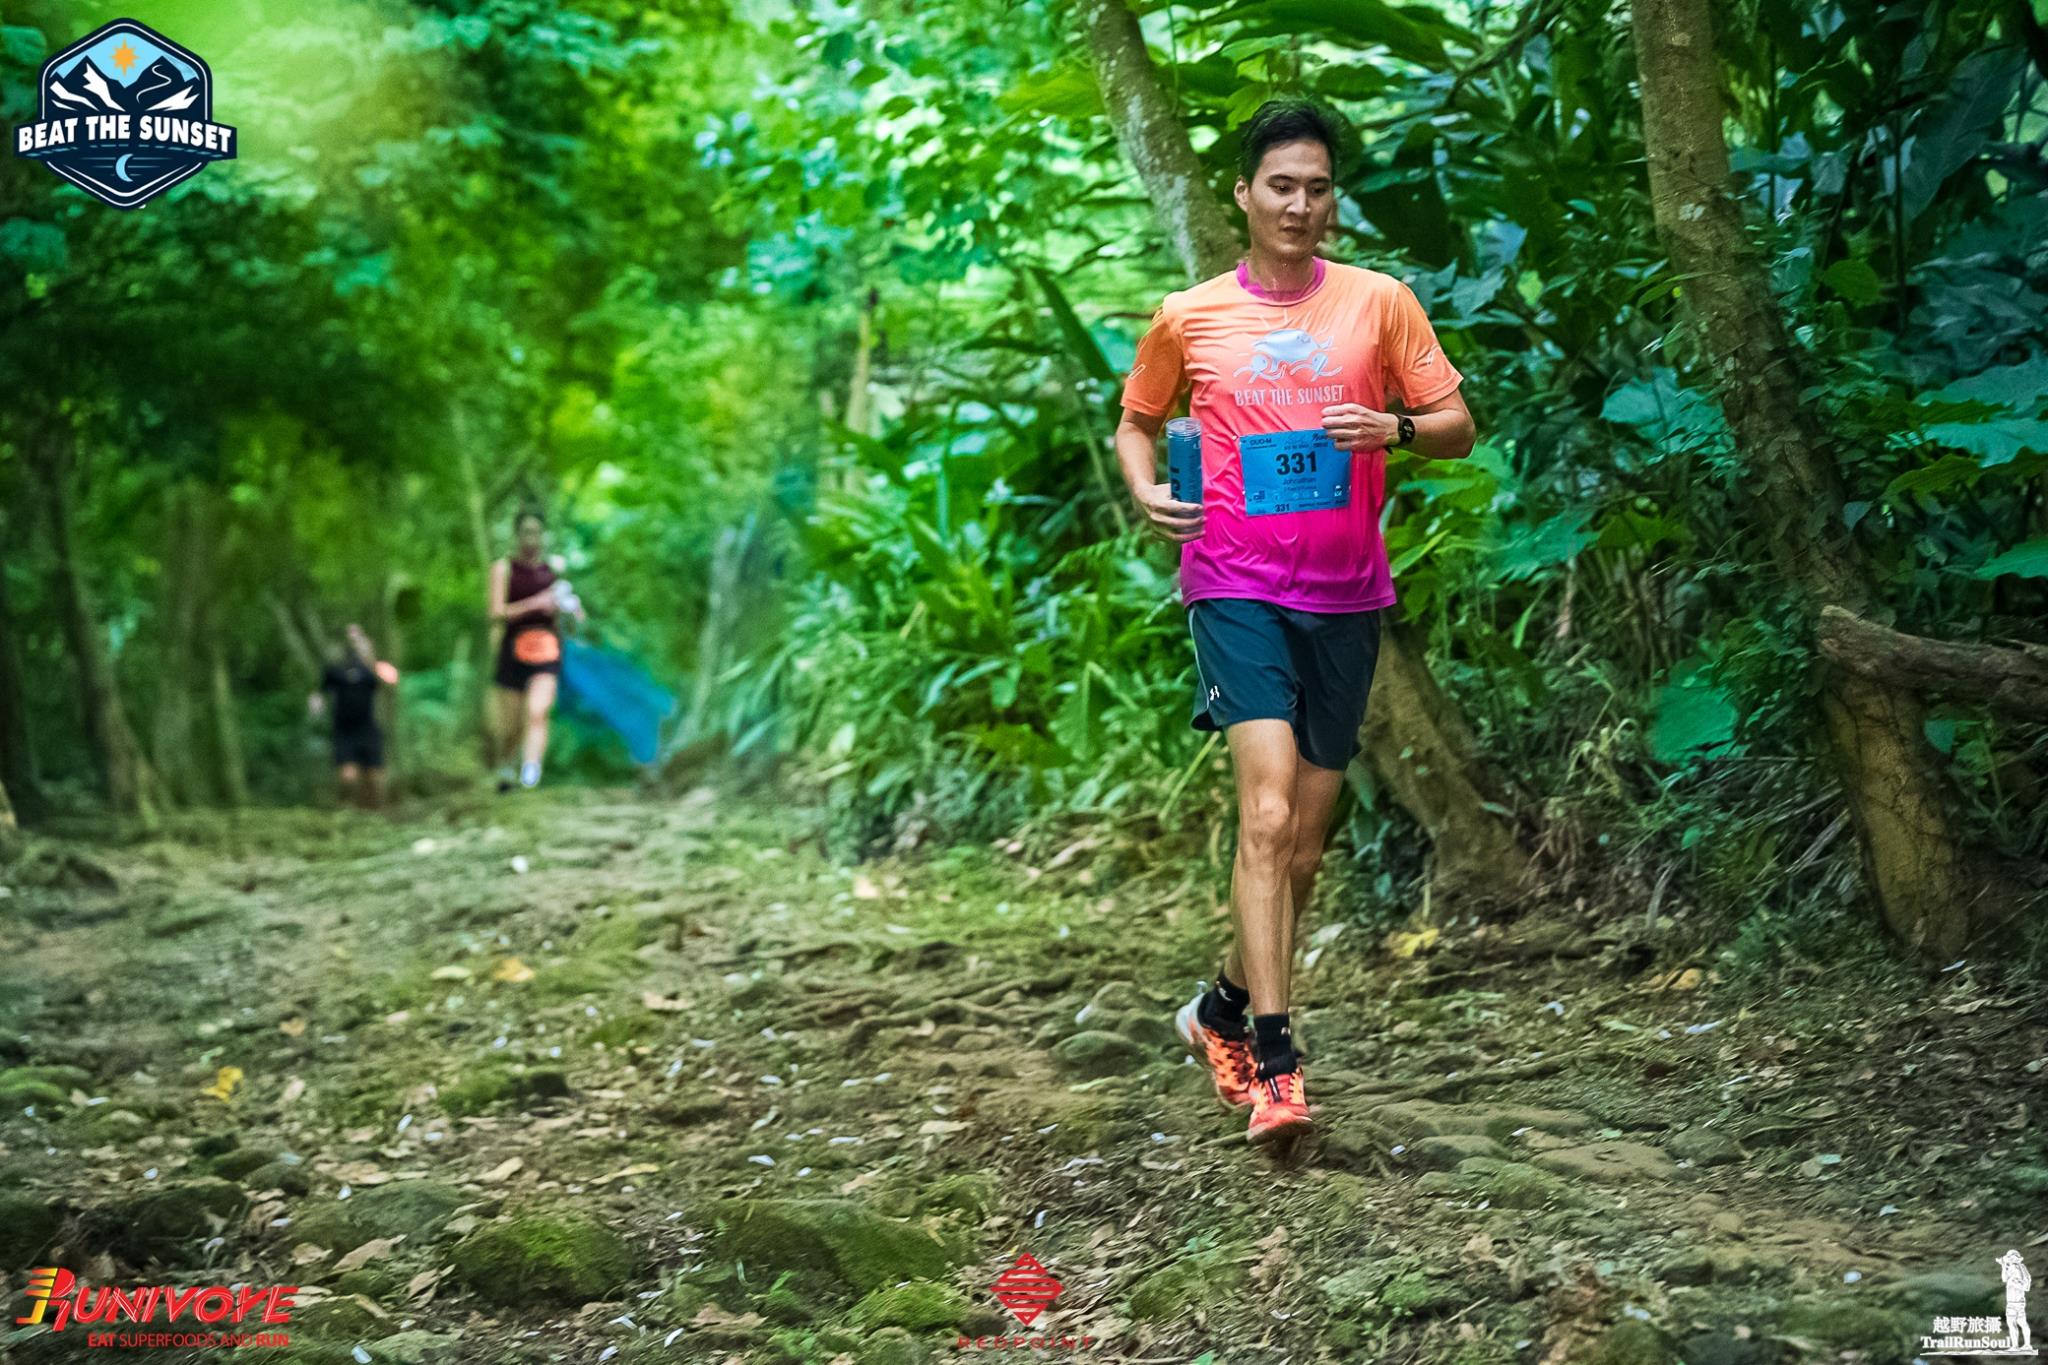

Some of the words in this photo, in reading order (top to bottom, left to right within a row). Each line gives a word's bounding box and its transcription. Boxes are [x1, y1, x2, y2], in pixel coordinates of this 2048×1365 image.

[1235, 389, 1266, 407] BEAT
[1269, 388, 1293, 406] THE
[1297, 385, 1344, 404] SUNSET
[1276, 451, 1317, 476] 331
[1275, 503, 1290, 512] 331
